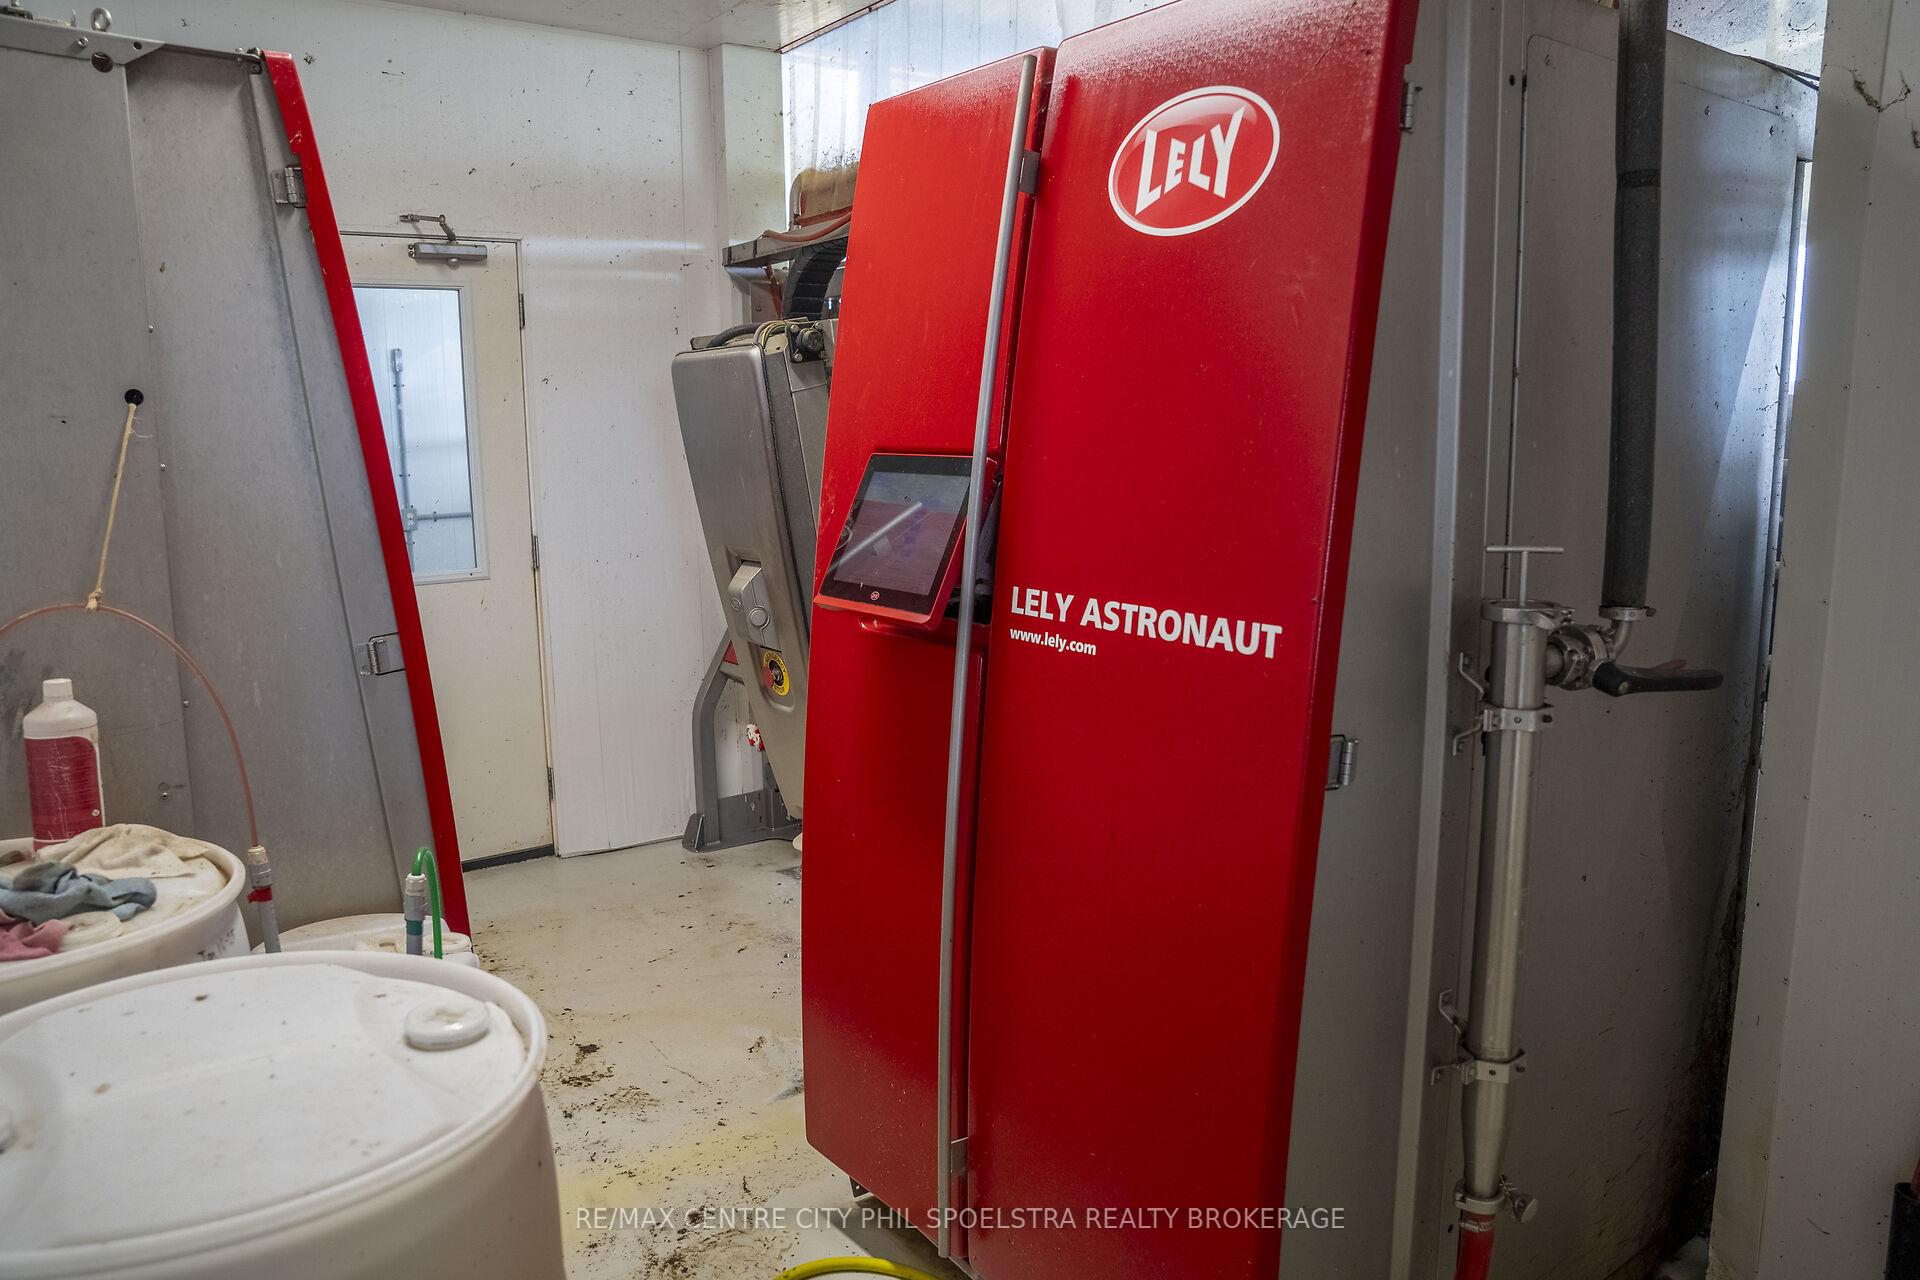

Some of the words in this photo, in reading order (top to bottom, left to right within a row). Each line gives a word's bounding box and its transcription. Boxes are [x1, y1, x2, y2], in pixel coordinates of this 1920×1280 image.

[1135, 106, 1246, 216] LELY
[1009, 628, 1097, 656] www.lely.com
[1011, 586, 1074, 622] LELY
[1080, 598, 1282, 659] ASTRONAUT
